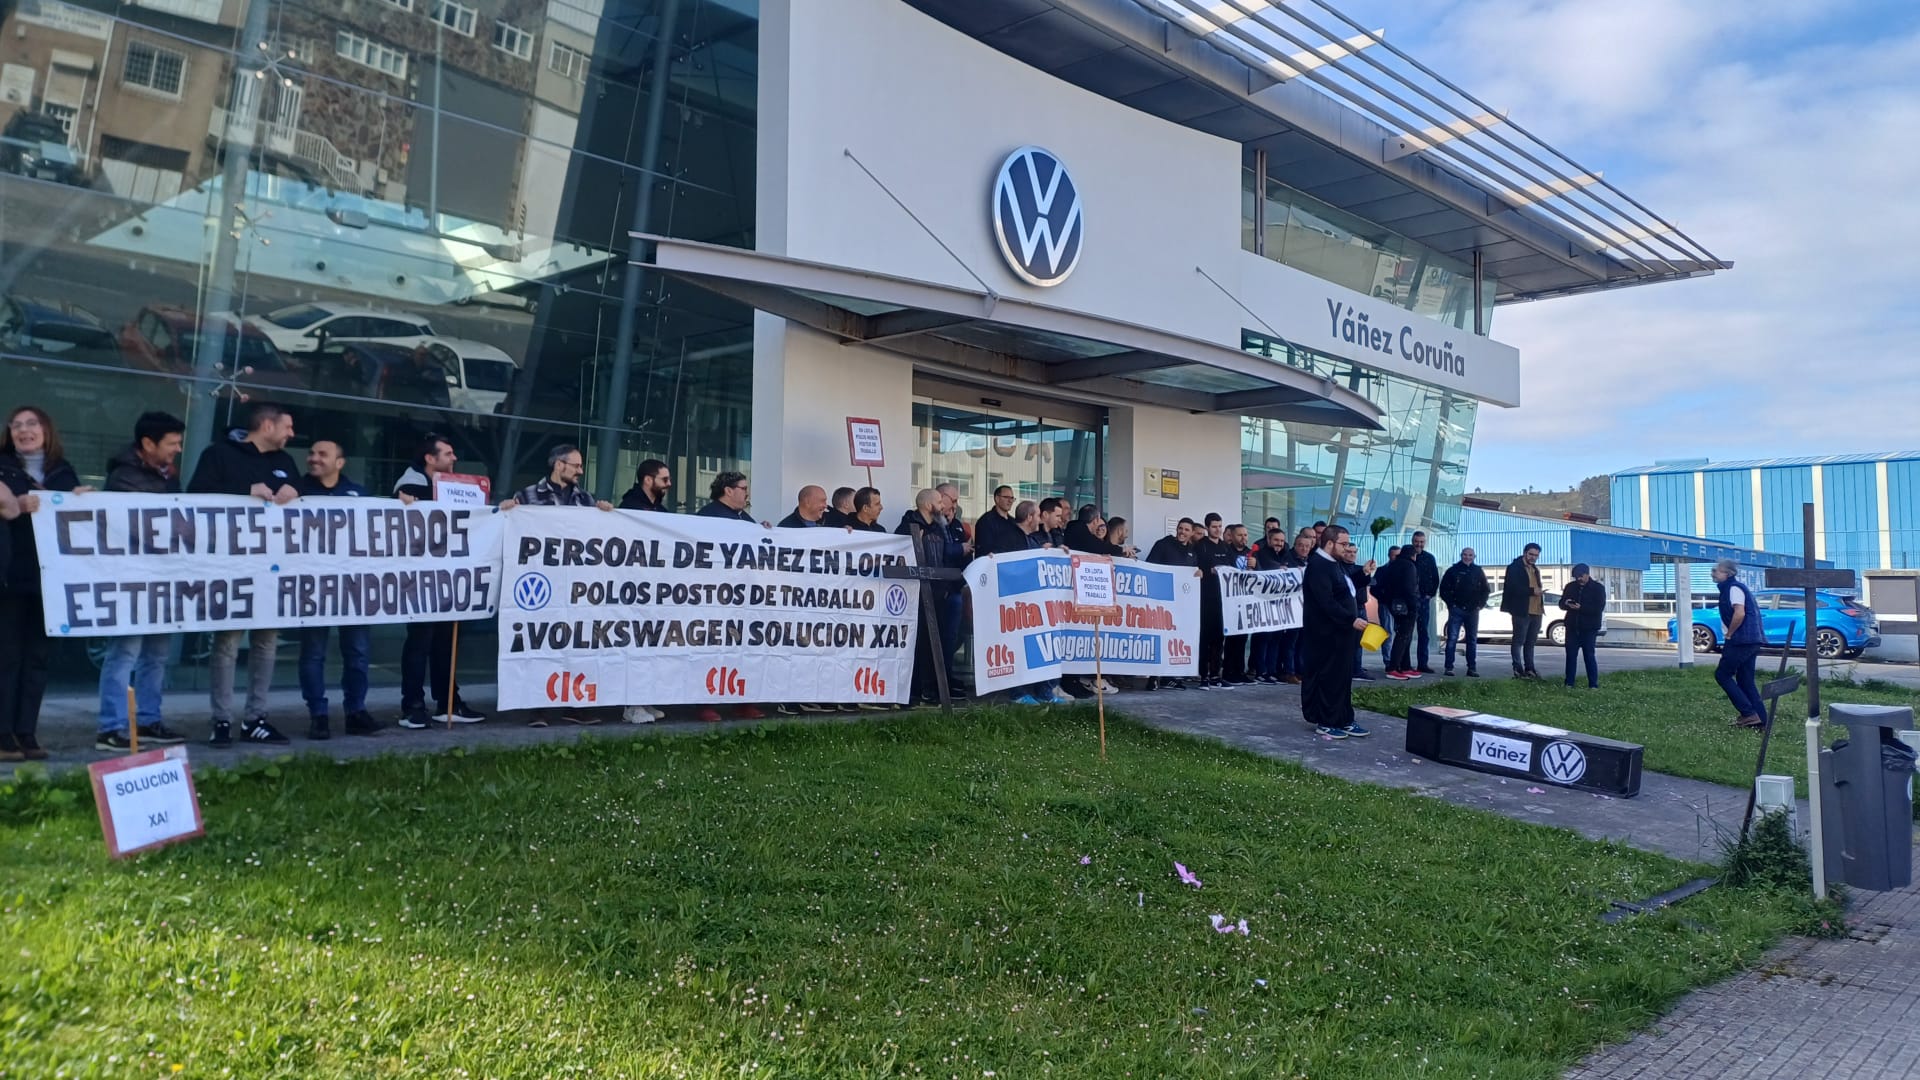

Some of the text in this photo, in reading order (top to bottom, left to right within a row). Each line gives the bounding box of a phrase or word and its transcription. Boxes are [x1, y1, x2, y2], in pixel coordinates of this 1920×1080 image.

[1326, 297, 1465, 377] Yáñez Coruña
[55, 507, 470, 557] CLIENTES-EMPLEADOS
[518, 536, 906, 577] PERSOAL DE YAÑEZ EN LOITA
[64, 577, 253, 627] ESTAMOS
[570, 580, 875, 611] POLOS POSTOS DE TRABALLO
[1000, 601, 1043, 633] loita
[748, 620, 866, 648] SOLUCION
[869, 624, 909, 649] XA!
[1168, 638, 1192, 657] CIG
[986, 644, 1015, 667] CIG
[546, 671, 597, 702] CIG
[706, 666, 746, 696] CIG
[854, 667, 886, 696] CIG
[1475, 740, 1528, 764] Yáñez
[116, 770, 179, 797] SOLUCIÓN
[148, 811, 168, 828] XA!
